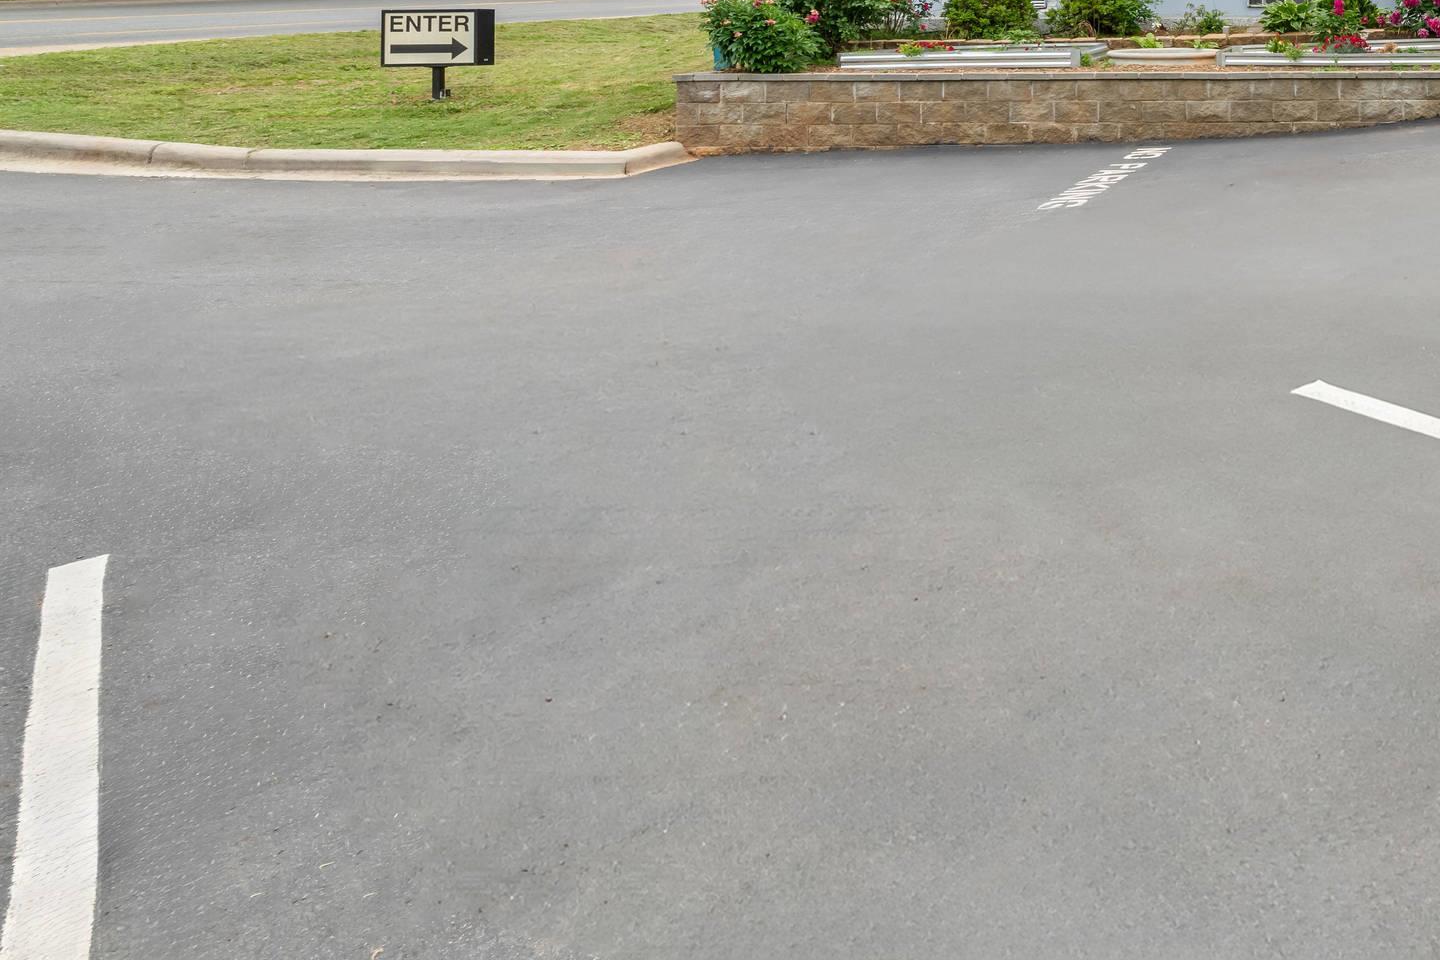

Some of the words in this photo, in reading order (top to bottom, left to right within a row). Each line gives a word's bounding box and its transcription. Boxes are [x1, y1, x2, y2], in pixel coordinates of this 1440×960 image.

[390, 15, 469, 32] ENTER
[1123, 147, 1172, 160] NO
[1037, 162, 1148, 210] PARKING
